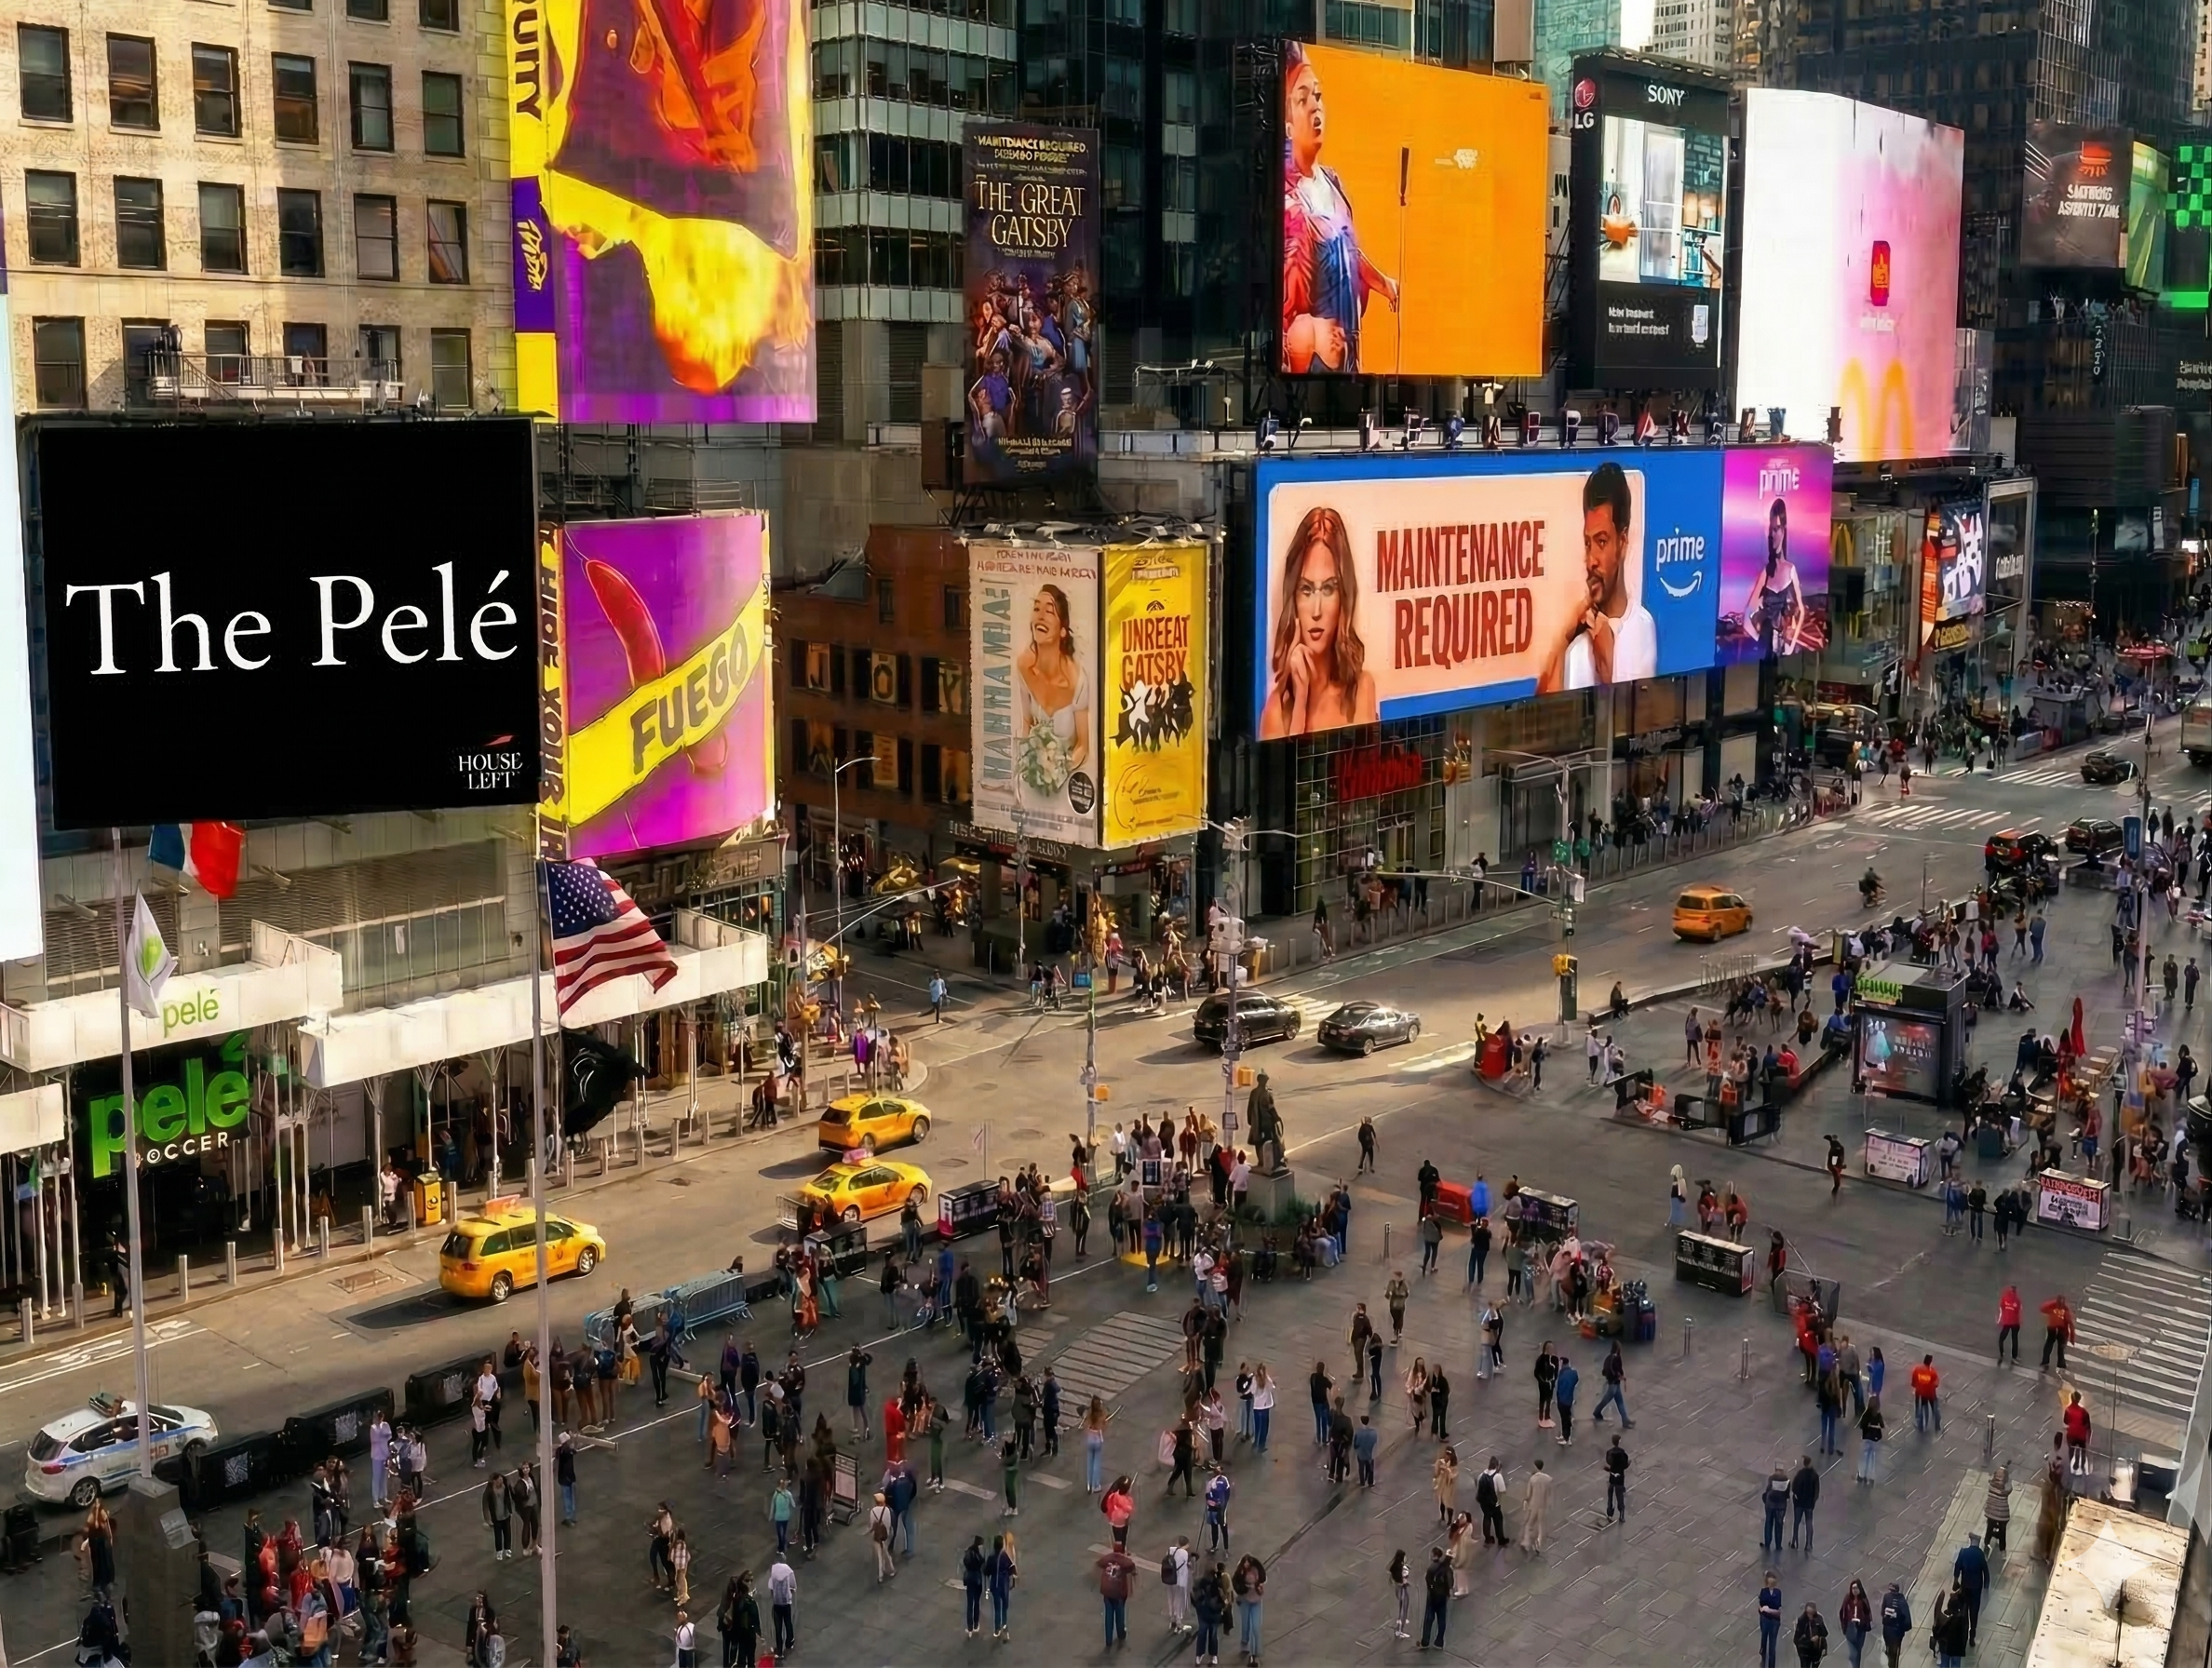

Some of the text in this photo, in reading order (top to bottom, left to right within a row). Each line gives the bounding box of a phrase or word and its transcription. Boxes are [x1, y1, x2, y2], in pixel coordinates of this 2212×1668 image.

[512, 0, 542, 122] UITY
[1647, 84, 1685, 107] SONY
[1573, 112, 1595, 129] LG
[975, 180, 1087, 216] THE GREAT
[991, 214, 1073, 248] GATSBY
[1376, 519, 1545, 593] MAINTENANCE
[1656, 527, 1706, 572] prime
[65, 560, 519, 675] The Pelé
[1395, 587, 1533, 670] REQUIRED
[1121, 650, 1187, 689] GATSBY
[629, 621, 749, 775] FUEGO
[458, 751, 523, 772] HOUSE
[468, 771, 517, 789] LEFT
[163, 988, 220, 1038] pelé
[89, 1033, 250, 1178] pelé
[134, 1131, 229, 1169] OCCER
